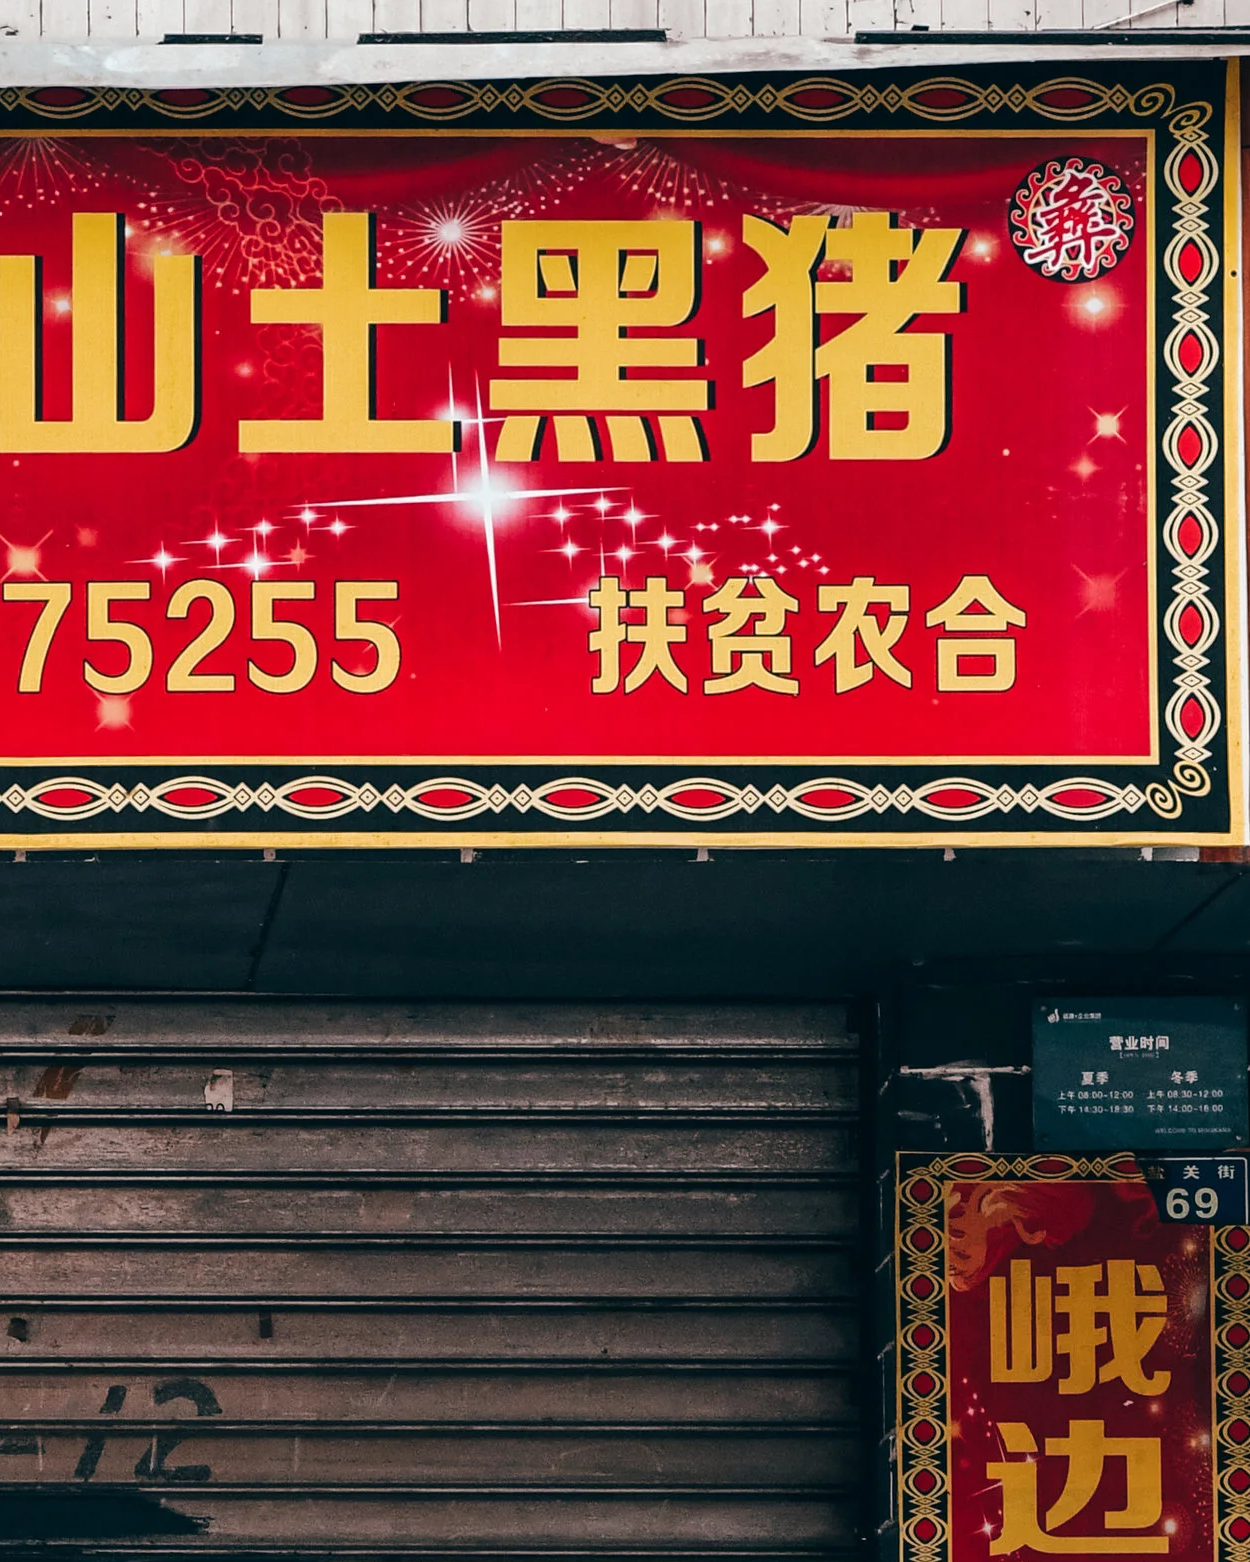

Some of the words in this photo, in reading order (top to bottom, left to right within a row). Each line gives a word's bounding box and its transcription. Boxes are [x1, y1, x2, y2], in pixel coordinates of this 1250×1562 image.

[588, 575, 1028, 696] 扶贫农合
[1108, 1035, 1170, 1051] 营业时间
[1080, 1070, 1110, 1086] 夏季
[1170, 1070, 1199, 1085] 冬季
[1165, 1186, 1219, 1219] 69
